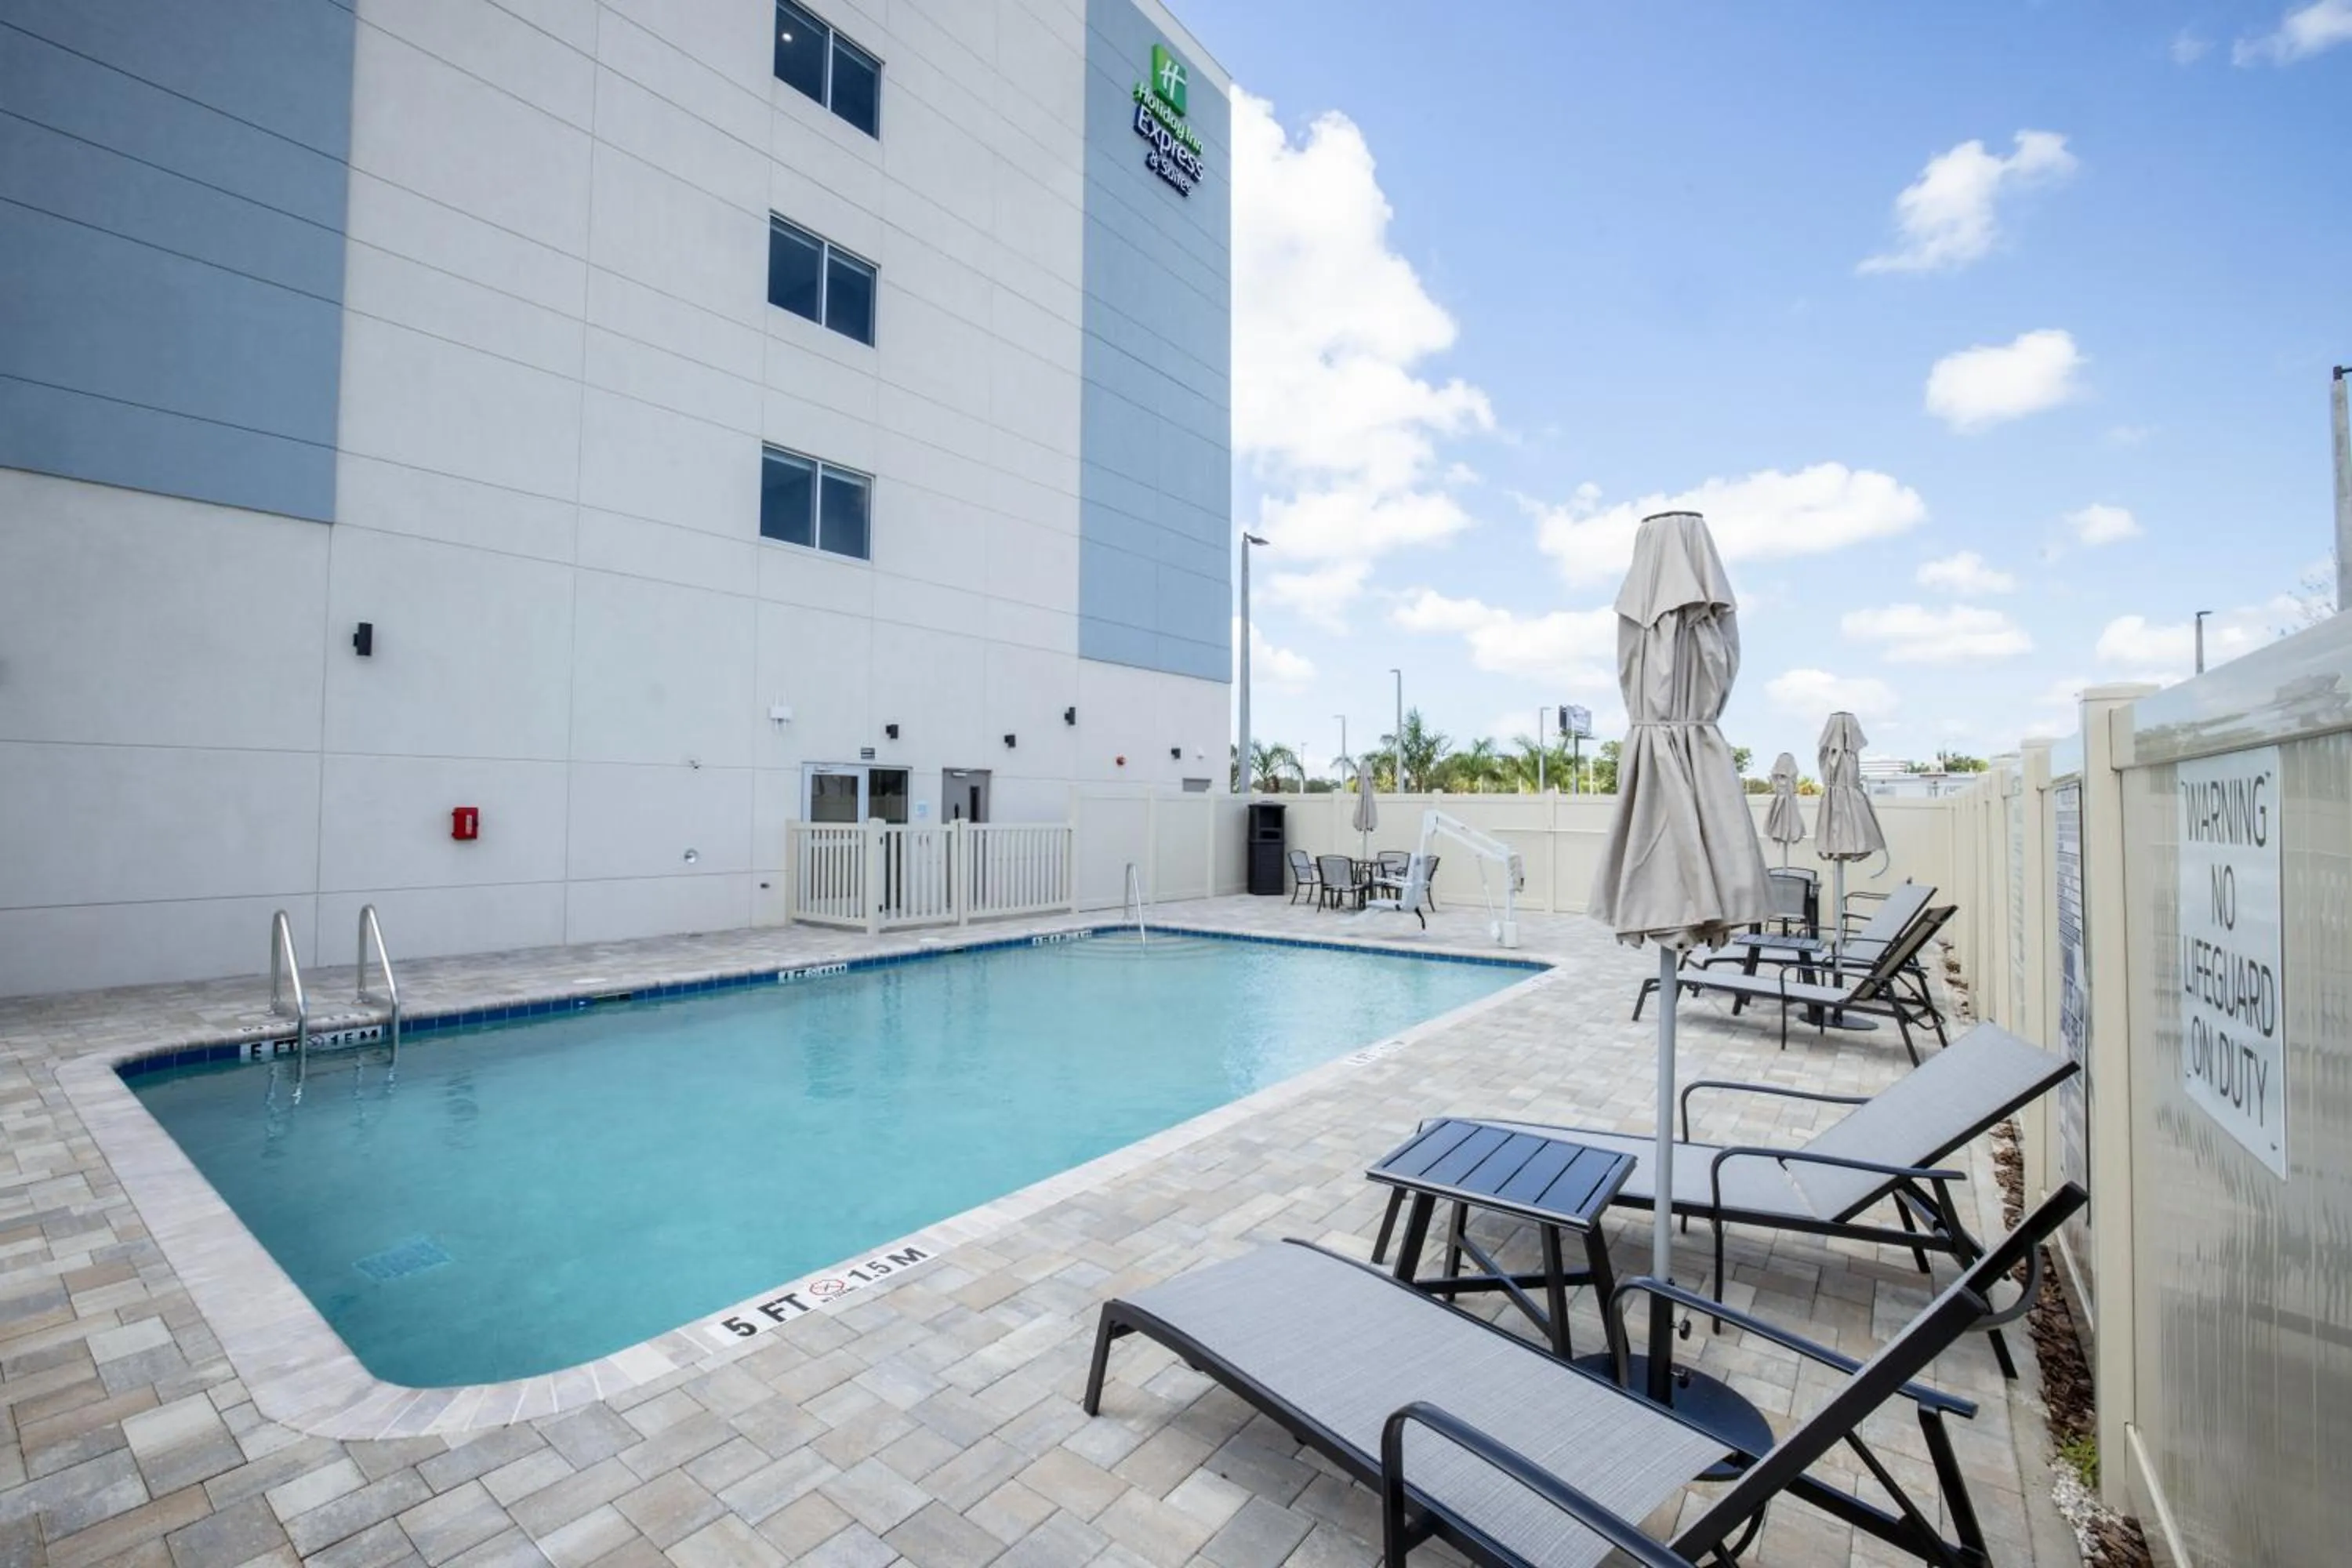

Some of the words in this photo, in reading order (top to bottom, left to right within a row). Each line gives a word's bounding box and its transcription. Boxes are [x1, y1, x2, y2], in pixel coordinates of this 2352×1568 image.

[1135, 82, 1187, 138] Holiday
[1186, 124, 1204, 155] Inn
[1137, 104, 1205, 181] Express
[1147, 151, 1159, 169] &
[1158, 160, 1193, 196] Suites
[2185, 775, 2267, 848] WARNING
[2212, 864, 2235, 931] NO
[2184, 935, 2274, 1038] LIFEGUARD
[2192, 1015, 2213, 1087] ON
[2220, 1032, 2268, 1129] DUTY
[721, 1316, 758, 1337] 5
[757, 1293, 810, 1323] FT
[848, 1261, 892, 1283] 1.5
[887, 1247, 928, 1266] M
